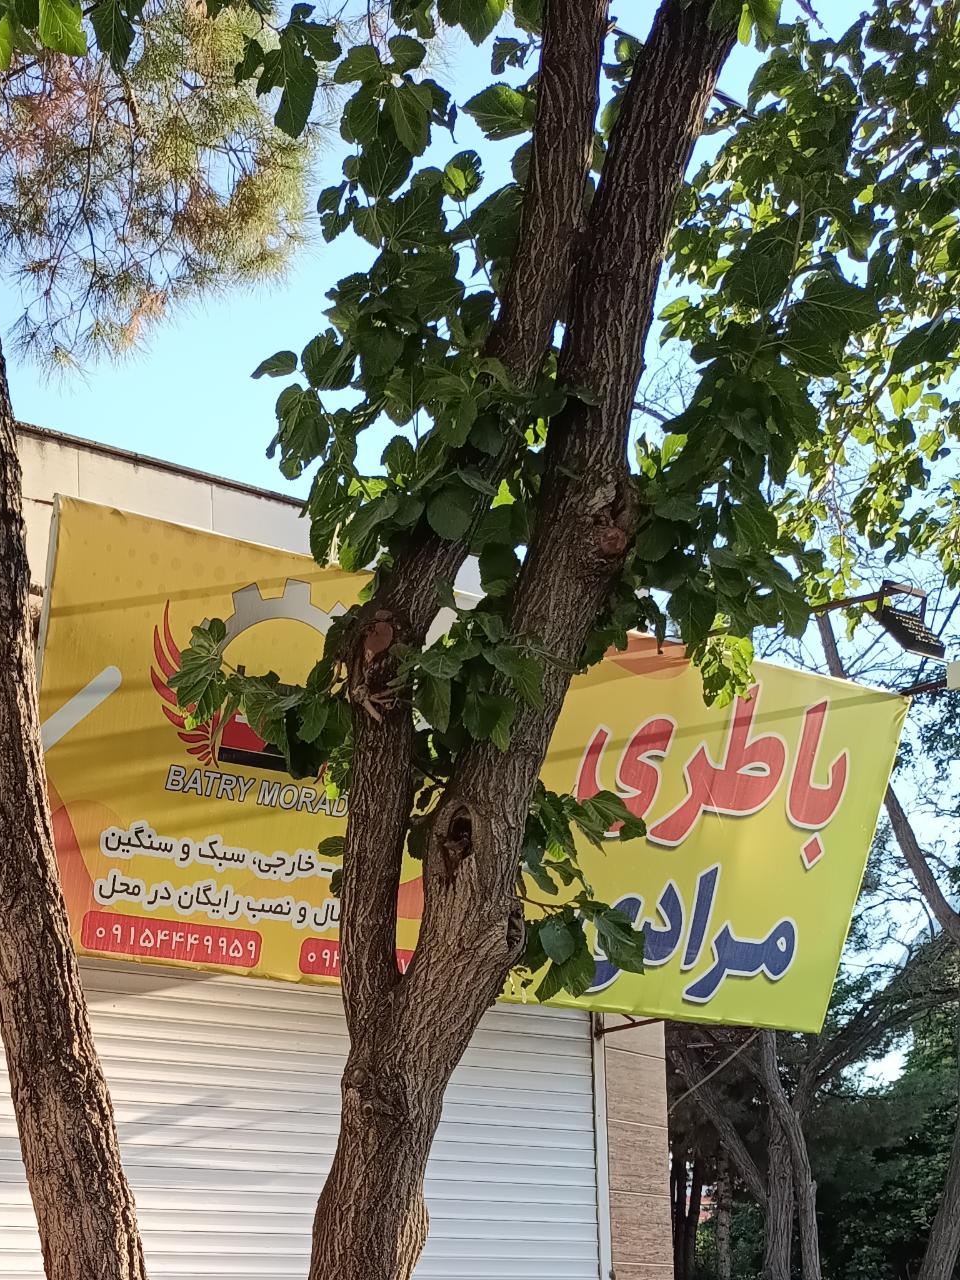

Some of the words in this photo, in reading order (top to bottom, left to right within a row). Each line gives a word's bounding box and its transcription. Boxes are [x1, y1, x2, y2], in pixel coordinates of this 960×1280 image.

[165, 764, 257, 804] BATRY
[574, 683, 849, 871] باطری
[104, 825, 174, 854] سنگین
[179, 841, 191, 861] و
[198, 840, 246, 868] سبک
[98, 874, 142, 900] محل
[147, 885, 171, 905] در
[177, 884, 240, 916] رایگان
[246, 900, 292, 920] نصب
[297, 906, 308, 924] و
[95, 925, 257, 960] ۰۹۱۵۴۴۴۹۹۵۹
